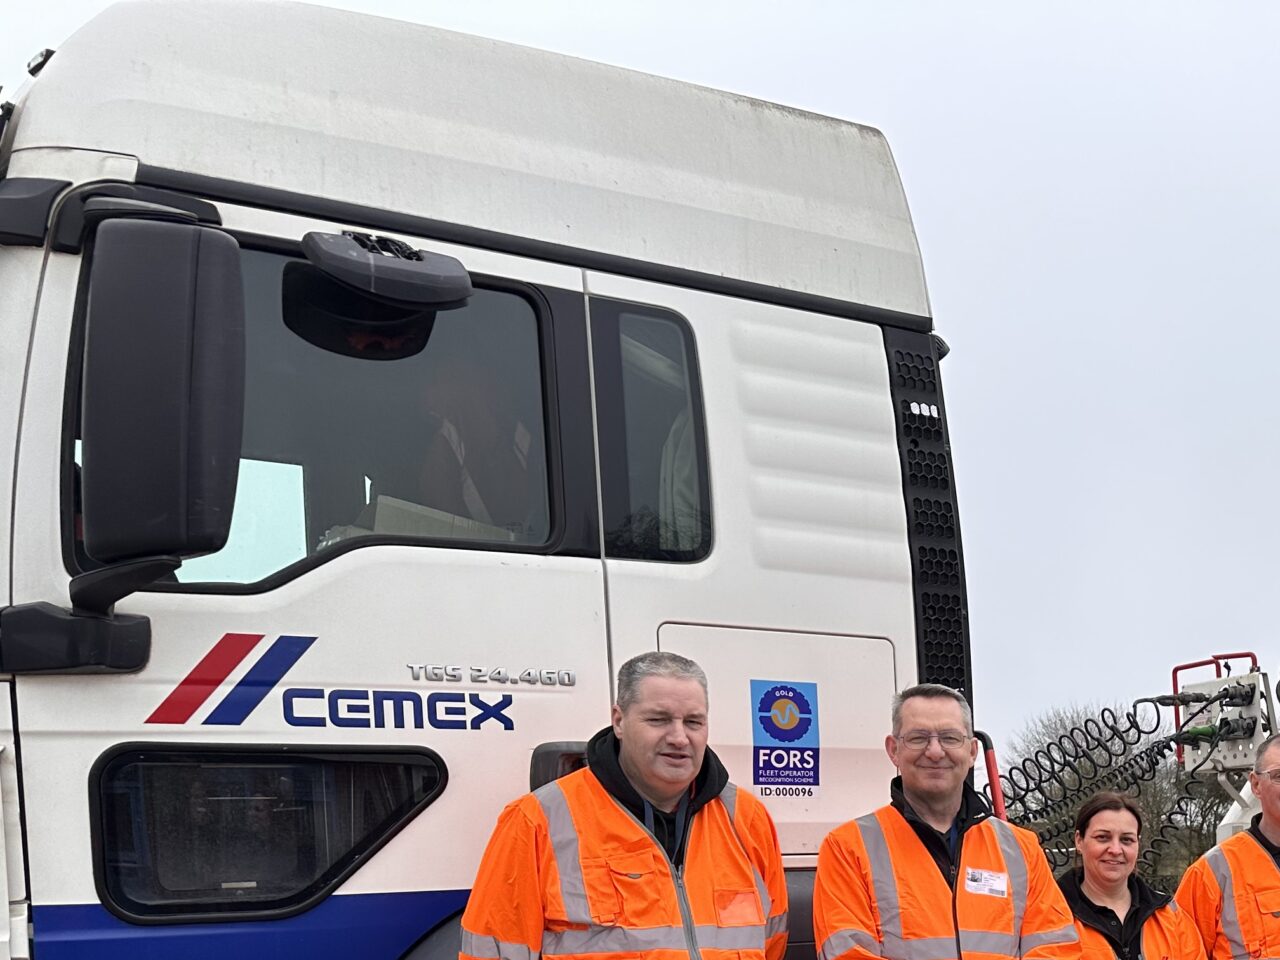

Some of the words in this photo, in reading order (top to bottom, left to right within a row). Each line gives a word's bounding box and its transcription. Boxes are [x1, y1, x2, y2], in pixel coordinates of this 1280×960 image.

[407, 663, 462, 682] TGS
[470, 666, 576, 686] 24.460
[282, 687, 515, 731] CEMEX
[758, 749, 815, 769] FORS
[759, 769, 778, 777] FLEET
[760, 787, 813, 797] ID:000096
